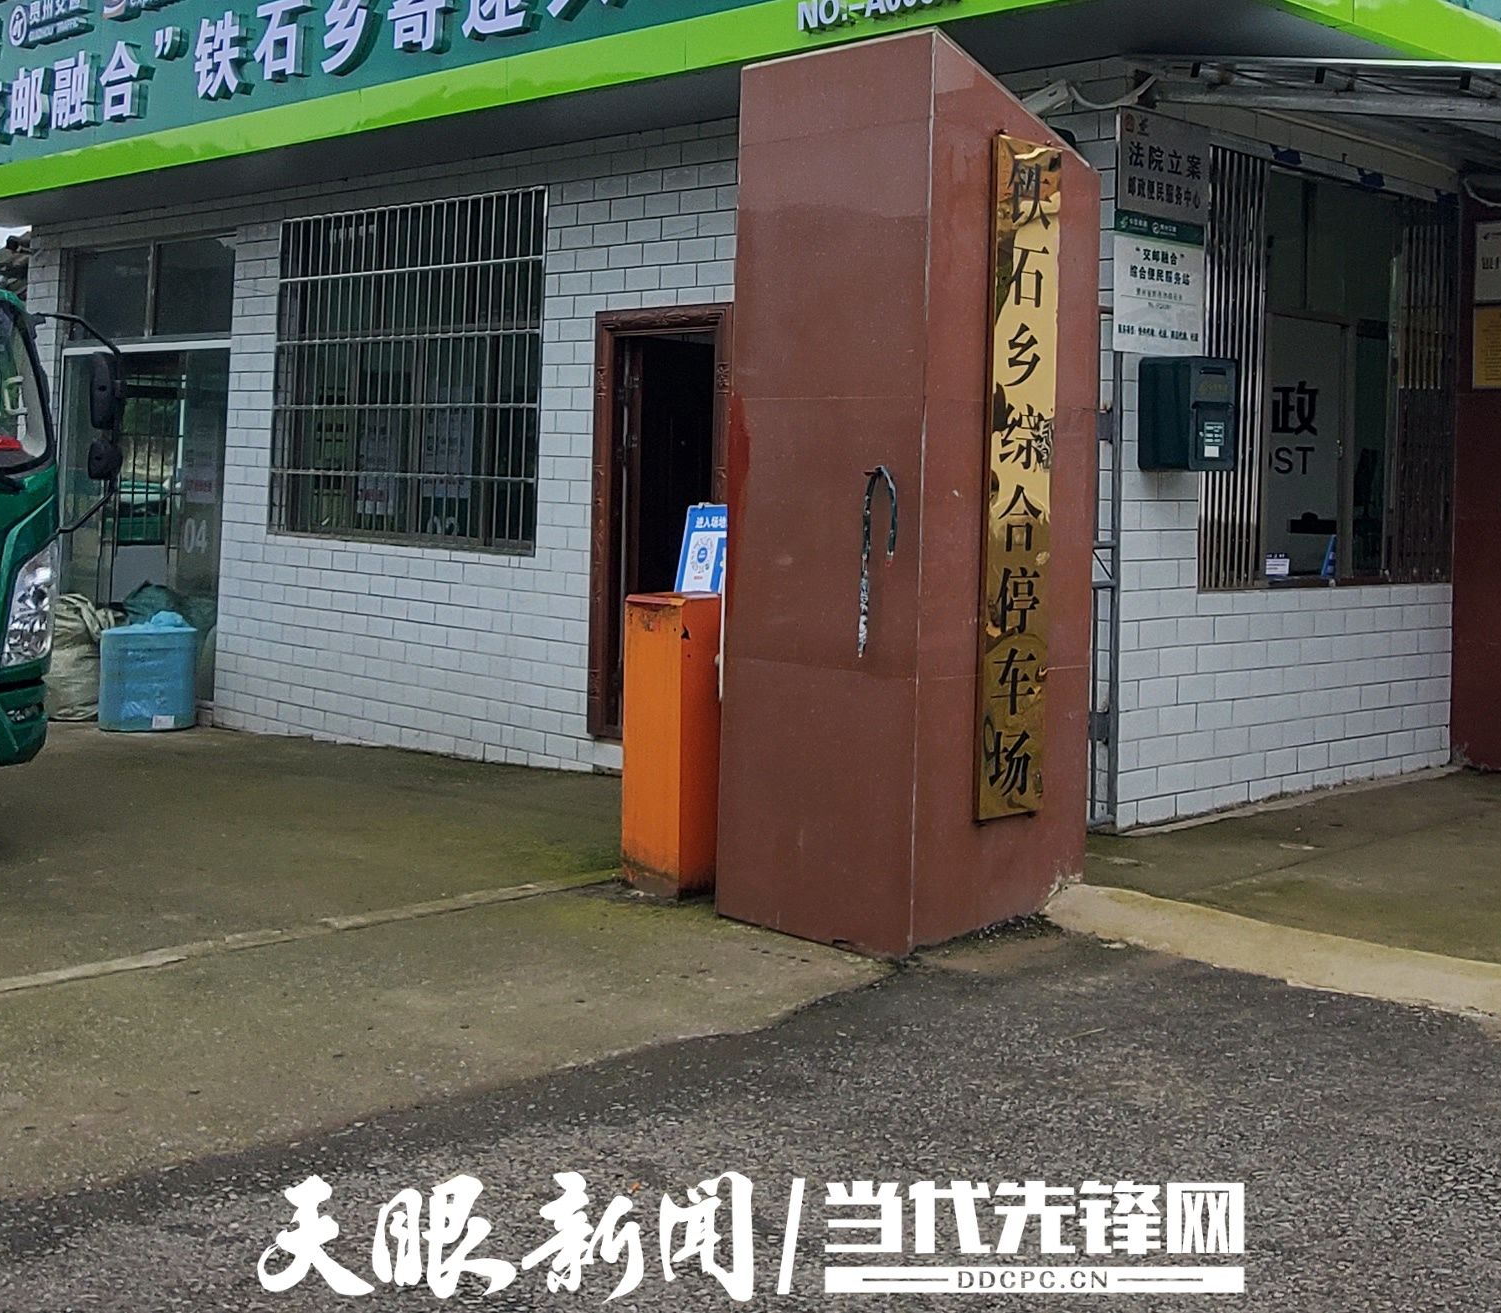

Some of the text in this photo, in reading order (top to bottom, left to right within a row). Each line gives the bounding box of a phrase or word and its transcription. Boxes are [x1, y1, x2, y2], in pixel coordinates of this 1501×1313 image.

[1128, 141, 1202, 181] 法院立案
[1271, 380, 1319, 436] 政
[988, 160, 1052, 798] 铁石乡综合停车场
[1268, 446, 1316, 475] ST
